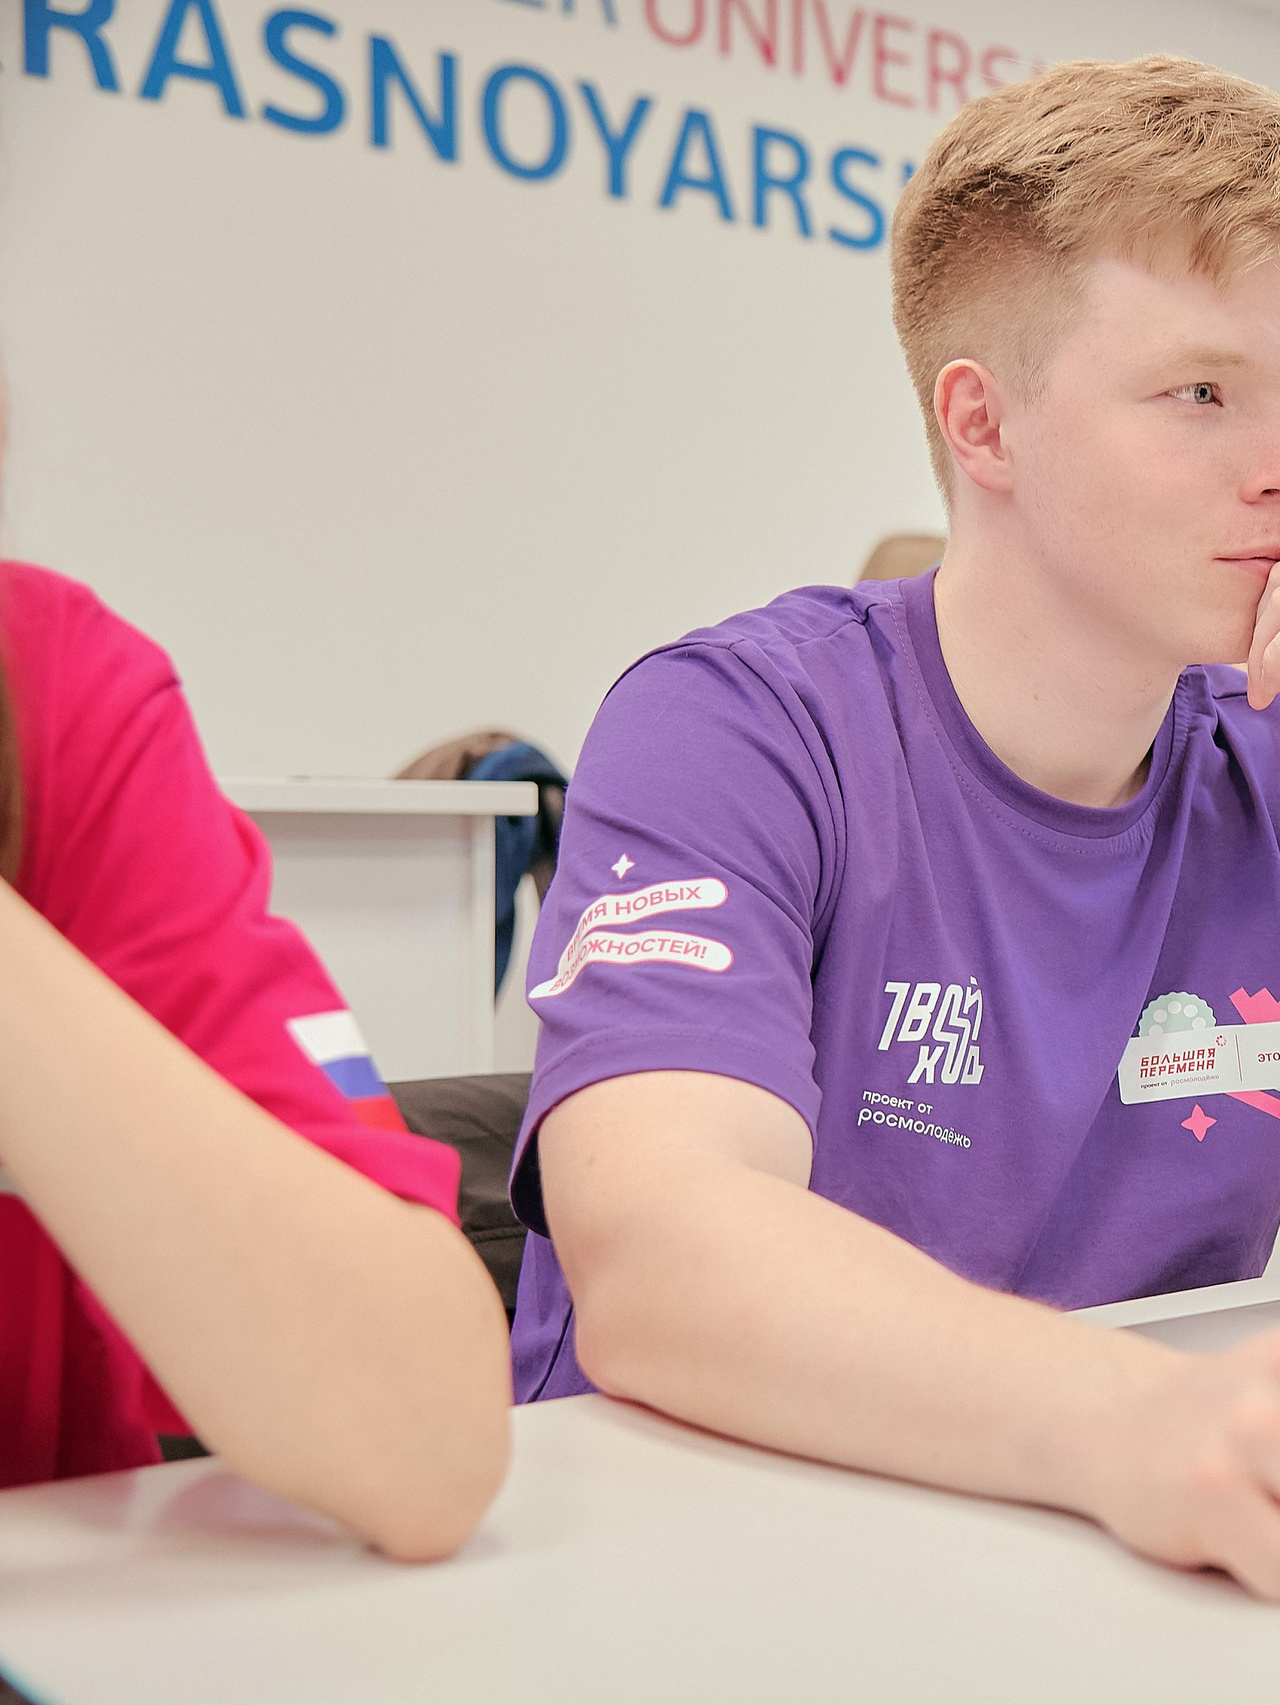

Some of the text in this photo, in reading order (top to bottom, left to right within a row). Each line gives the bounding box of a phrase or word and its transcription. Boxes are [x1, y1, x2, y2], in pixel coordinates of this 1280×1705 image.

[641, 0, 1046, 112] UNIVERS
[0, 0, 917, 252] RASNOYARS
[615, 886, 702, 915] НОВЫХ
[1139, 1059, 1215, 1079] ПЕРЕМЕНА
[1140, 1047, 1216, 1068] БОЛЬШАЯ
[1257, 1052, 1280, 1063] это
[862, 1090, 934, 1115] проект от
[857, 1107, 972, 1149] росмолодёжь
